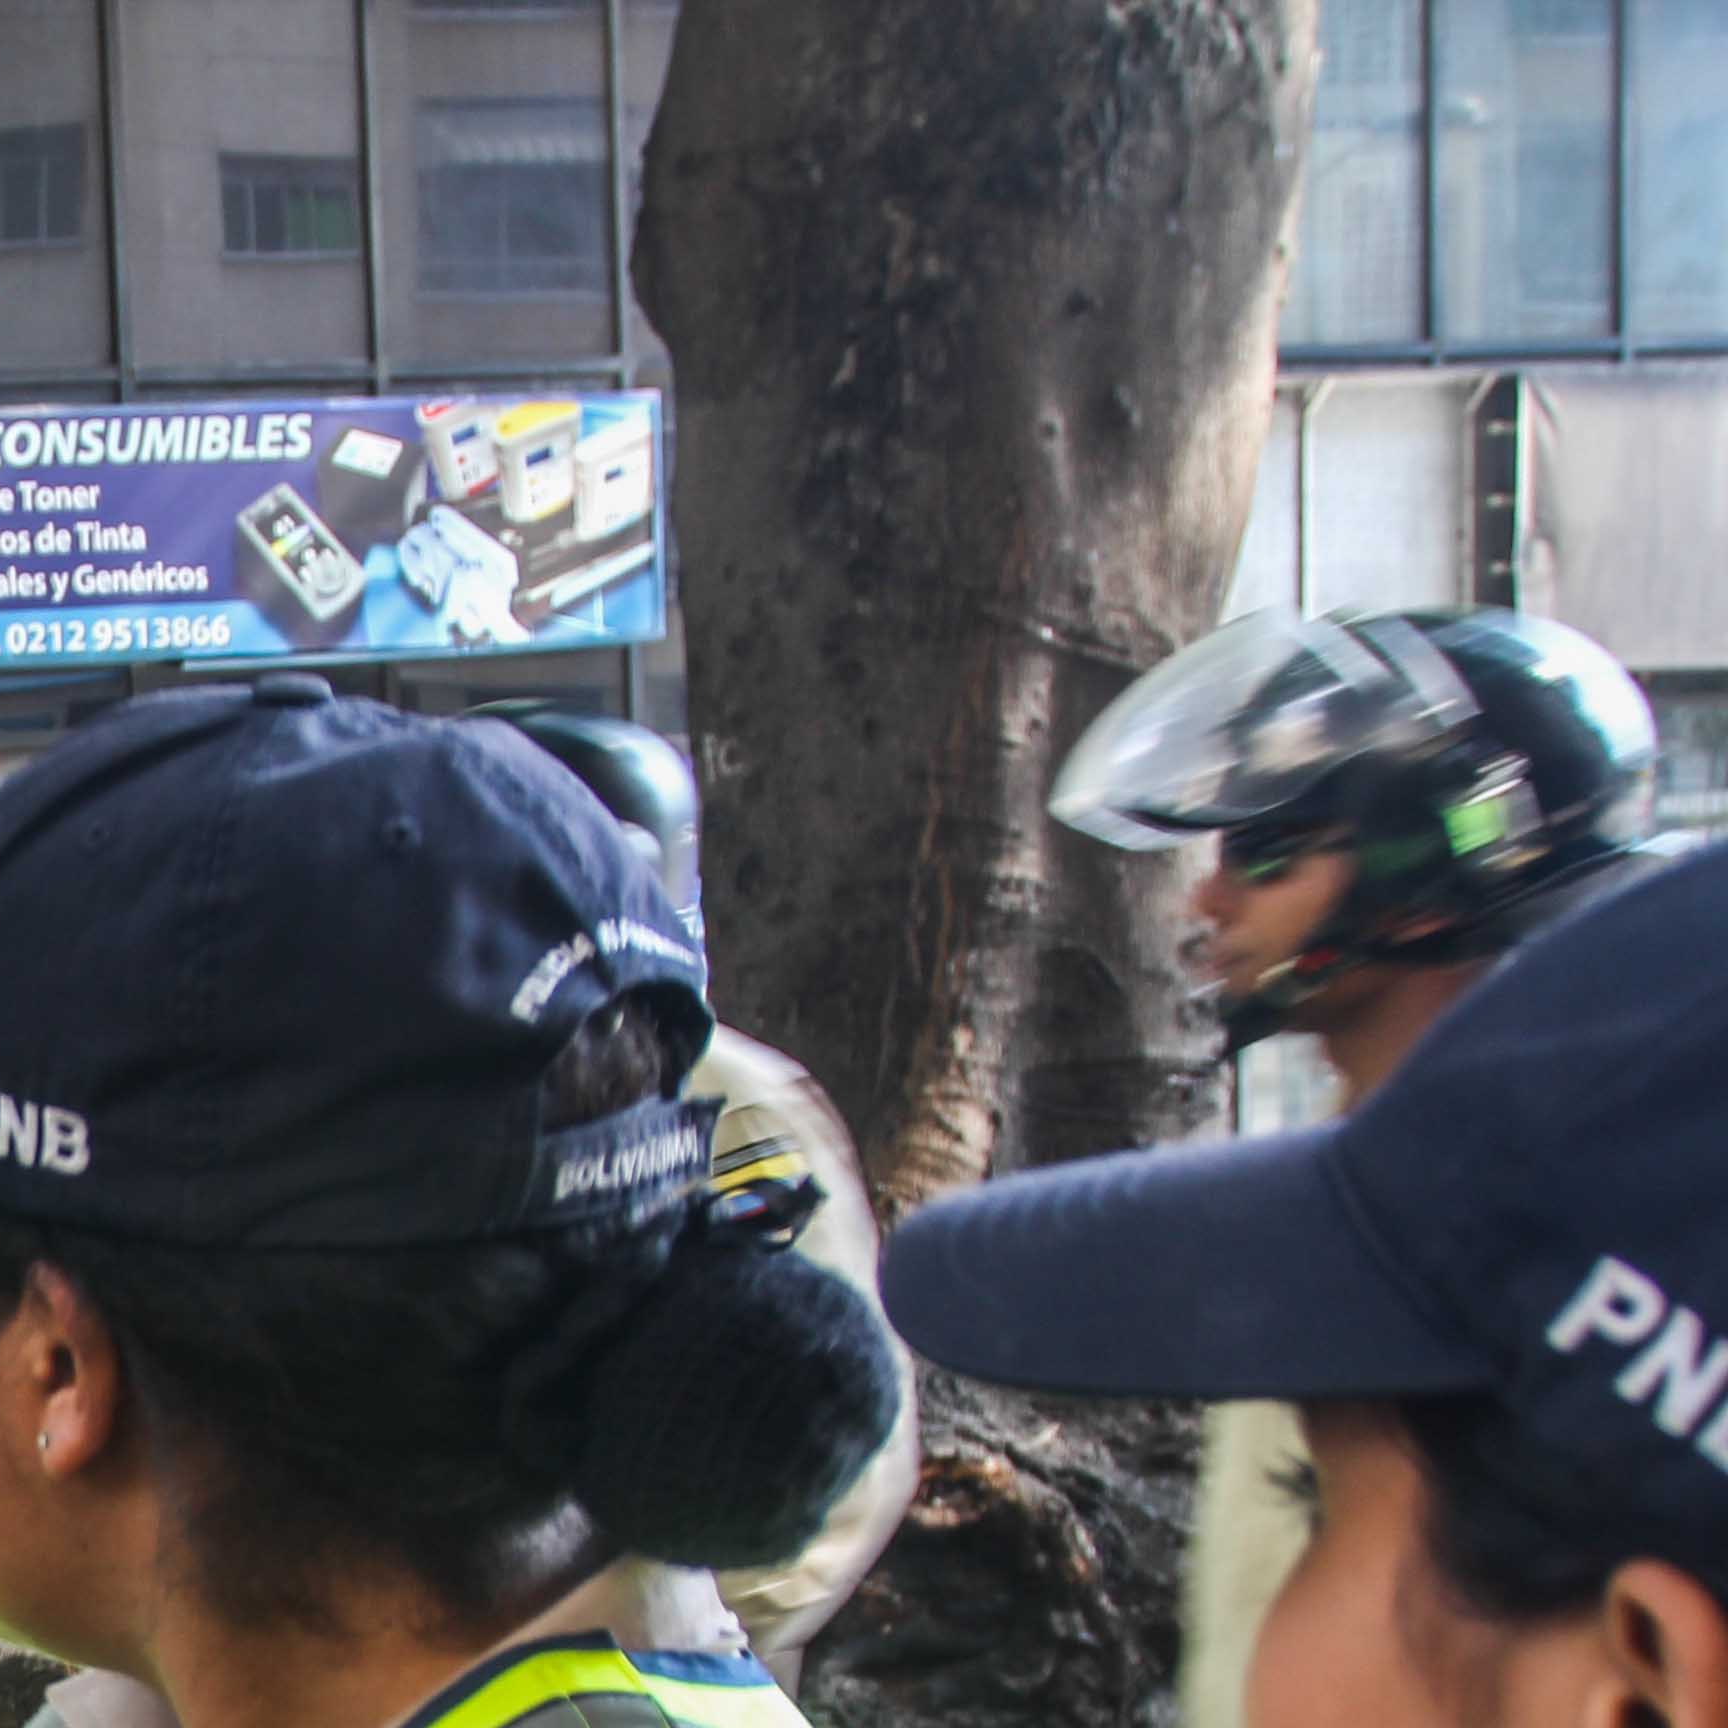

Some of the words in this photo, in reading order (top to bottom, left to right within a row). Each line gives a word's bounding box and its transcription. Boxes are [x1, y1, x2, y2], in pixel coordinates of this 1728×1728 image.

[18, 480, 102, 512] Toner
[34, 522, 71, 555] de
[75, 520, 147, 552] Tinta
[49, 569, 71, 602] y
[71, 560, 209, 595] Genéricos
[5, 618, 91, 655] 0212
[91, 613, 232, 652] 9513866
[1544, 1252, 1728, 1480] PN
